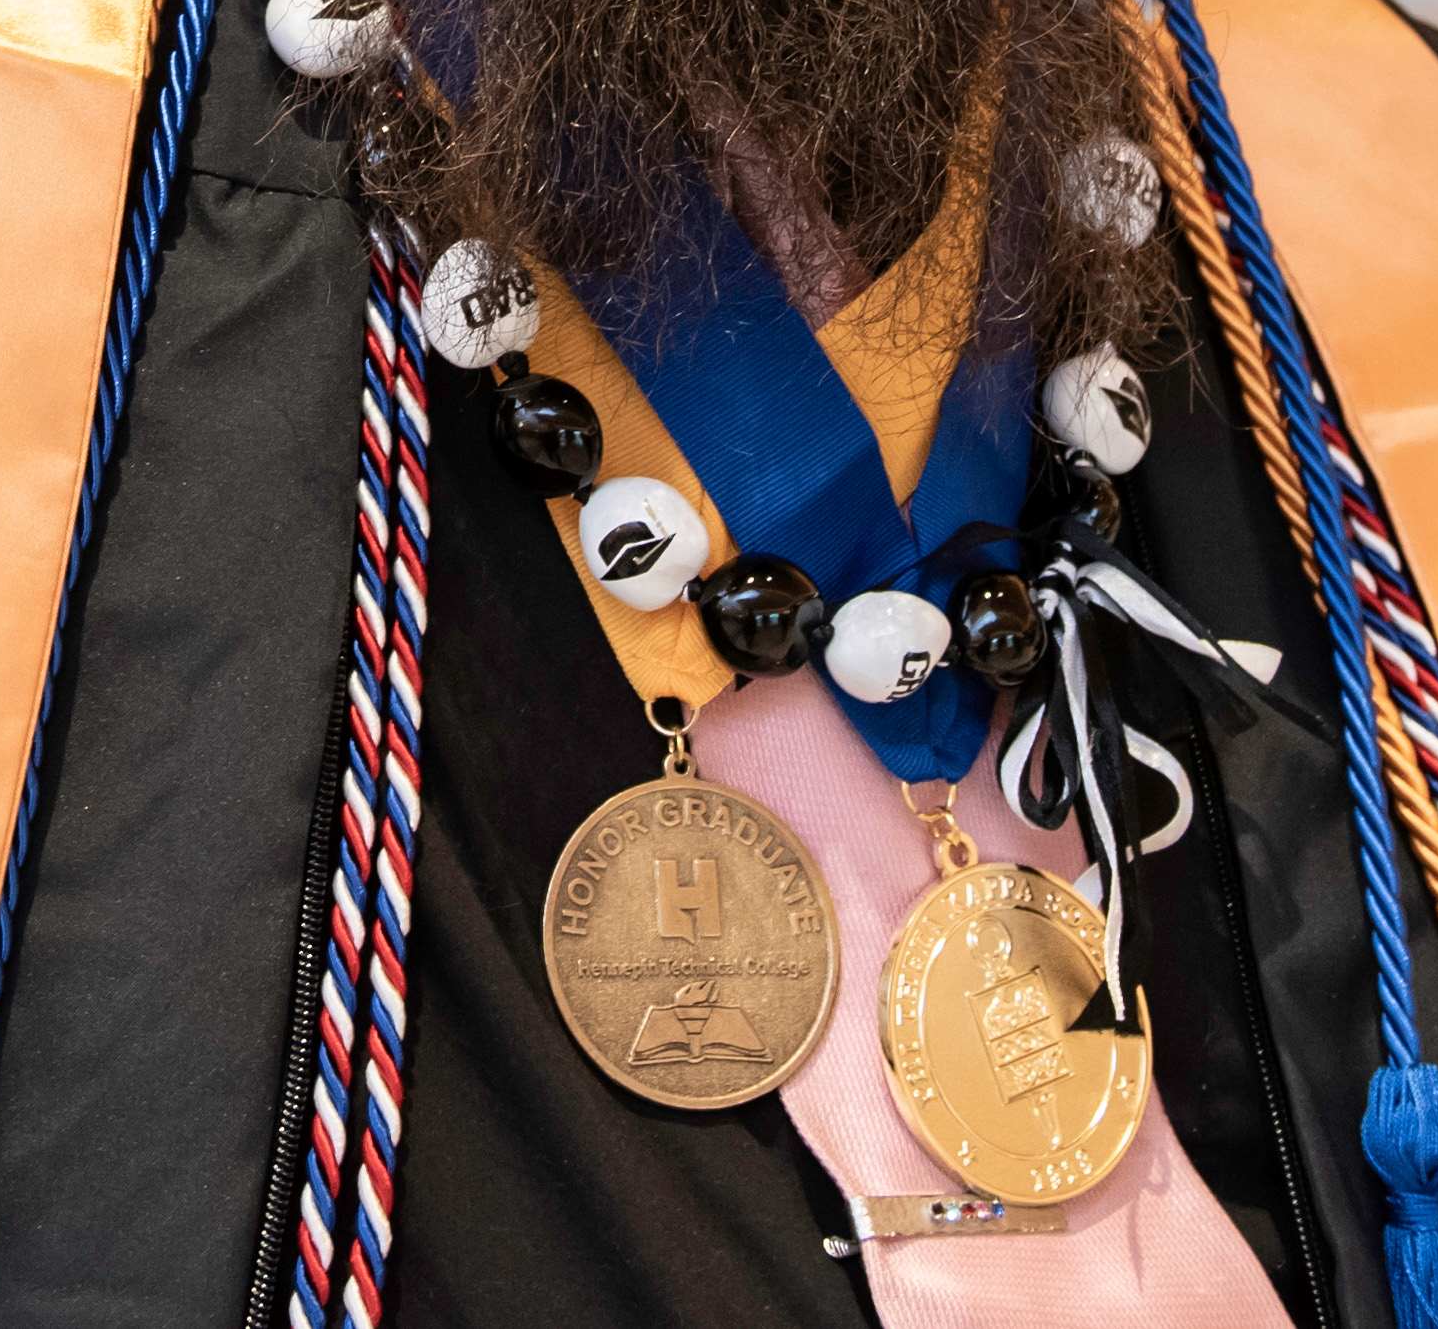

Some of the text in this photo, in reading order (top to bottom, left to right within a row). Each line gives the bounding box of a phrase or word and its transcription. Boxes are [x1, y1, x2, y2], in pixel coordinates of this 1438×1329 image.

[561, 796, 823, 937] HONOR GRADUATE
[577, 956, 811, 982] Hennepin Technical College
